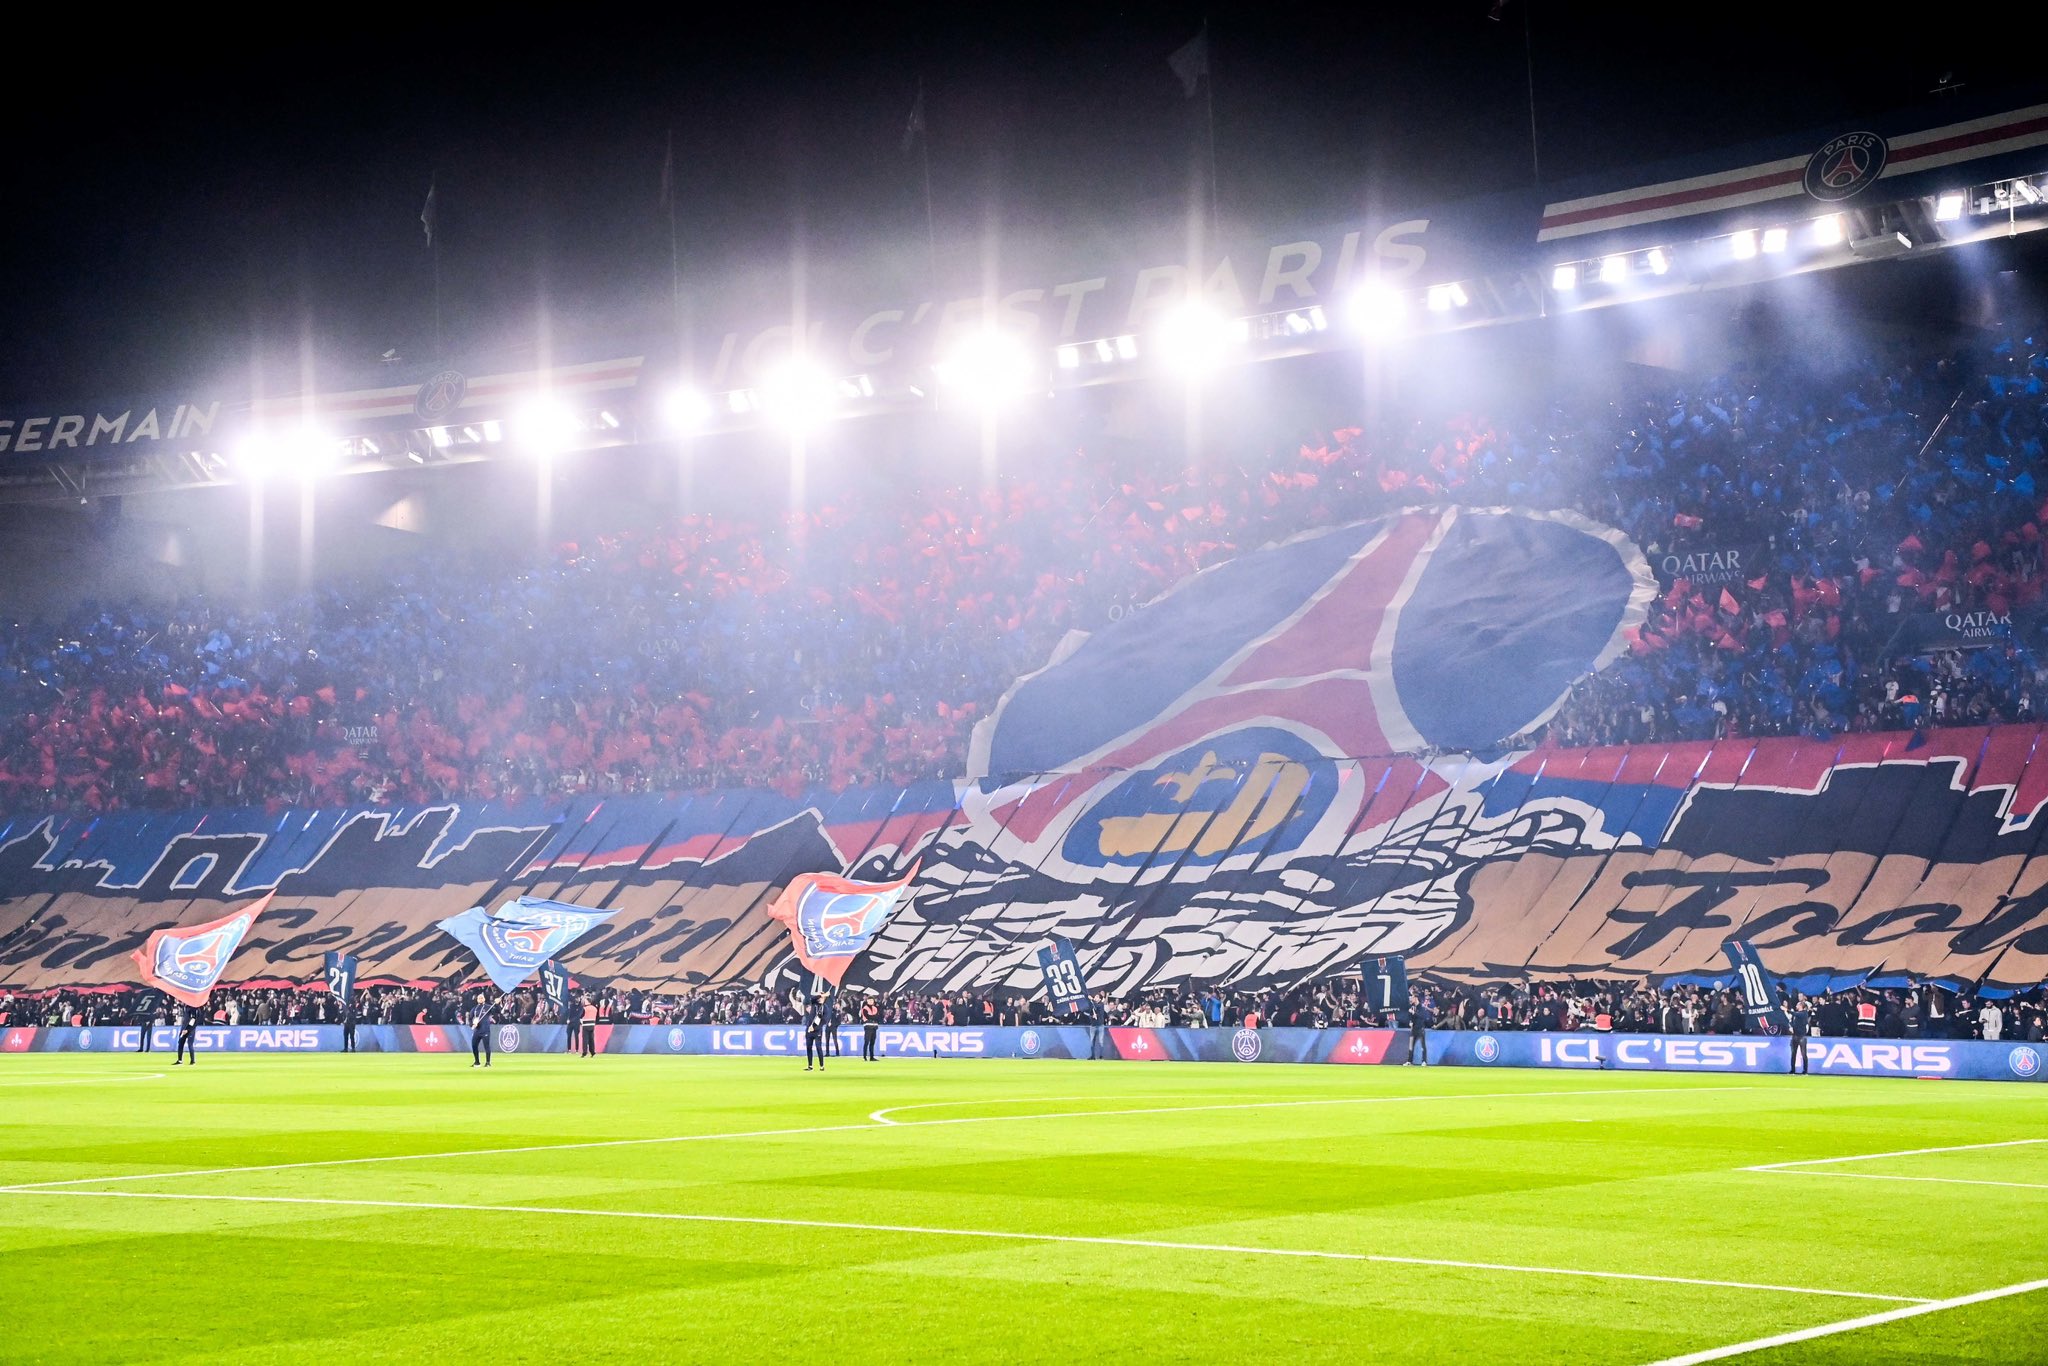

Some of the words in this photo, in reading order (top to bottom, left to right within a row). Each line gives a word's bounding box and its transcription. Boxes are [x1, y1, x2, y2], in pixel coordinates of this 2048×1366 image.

[1823, 134, 1876, 156] PARIS
[1126, 218, 1431, 330] PARIS
[1661, 549, 1741, 577] QATAR
[329, 967, 348, 999] 21
[543, 970, 563, 1000] 37
[1046, 960, 1081, 997] 33
[1377, 975, 1391, 1006] 7
[1738, 963, 1769, 1006] 10
[136, 995, 155, 1011] 5
[113, 1030, 141, 1048] IC
[153, 1029, 231, 1048] C'ST
[240, 1029, 319, 1047] PARIS
[713, 1030, 752, 1050] ICI
[880, 1031, 984, 1052] PARIS
[1541, 1038, 1599, 1063] ICI
[1616, 1038, 1770, 1066] C'EST
[1796, 1043, 1951, 1072] PARIS
